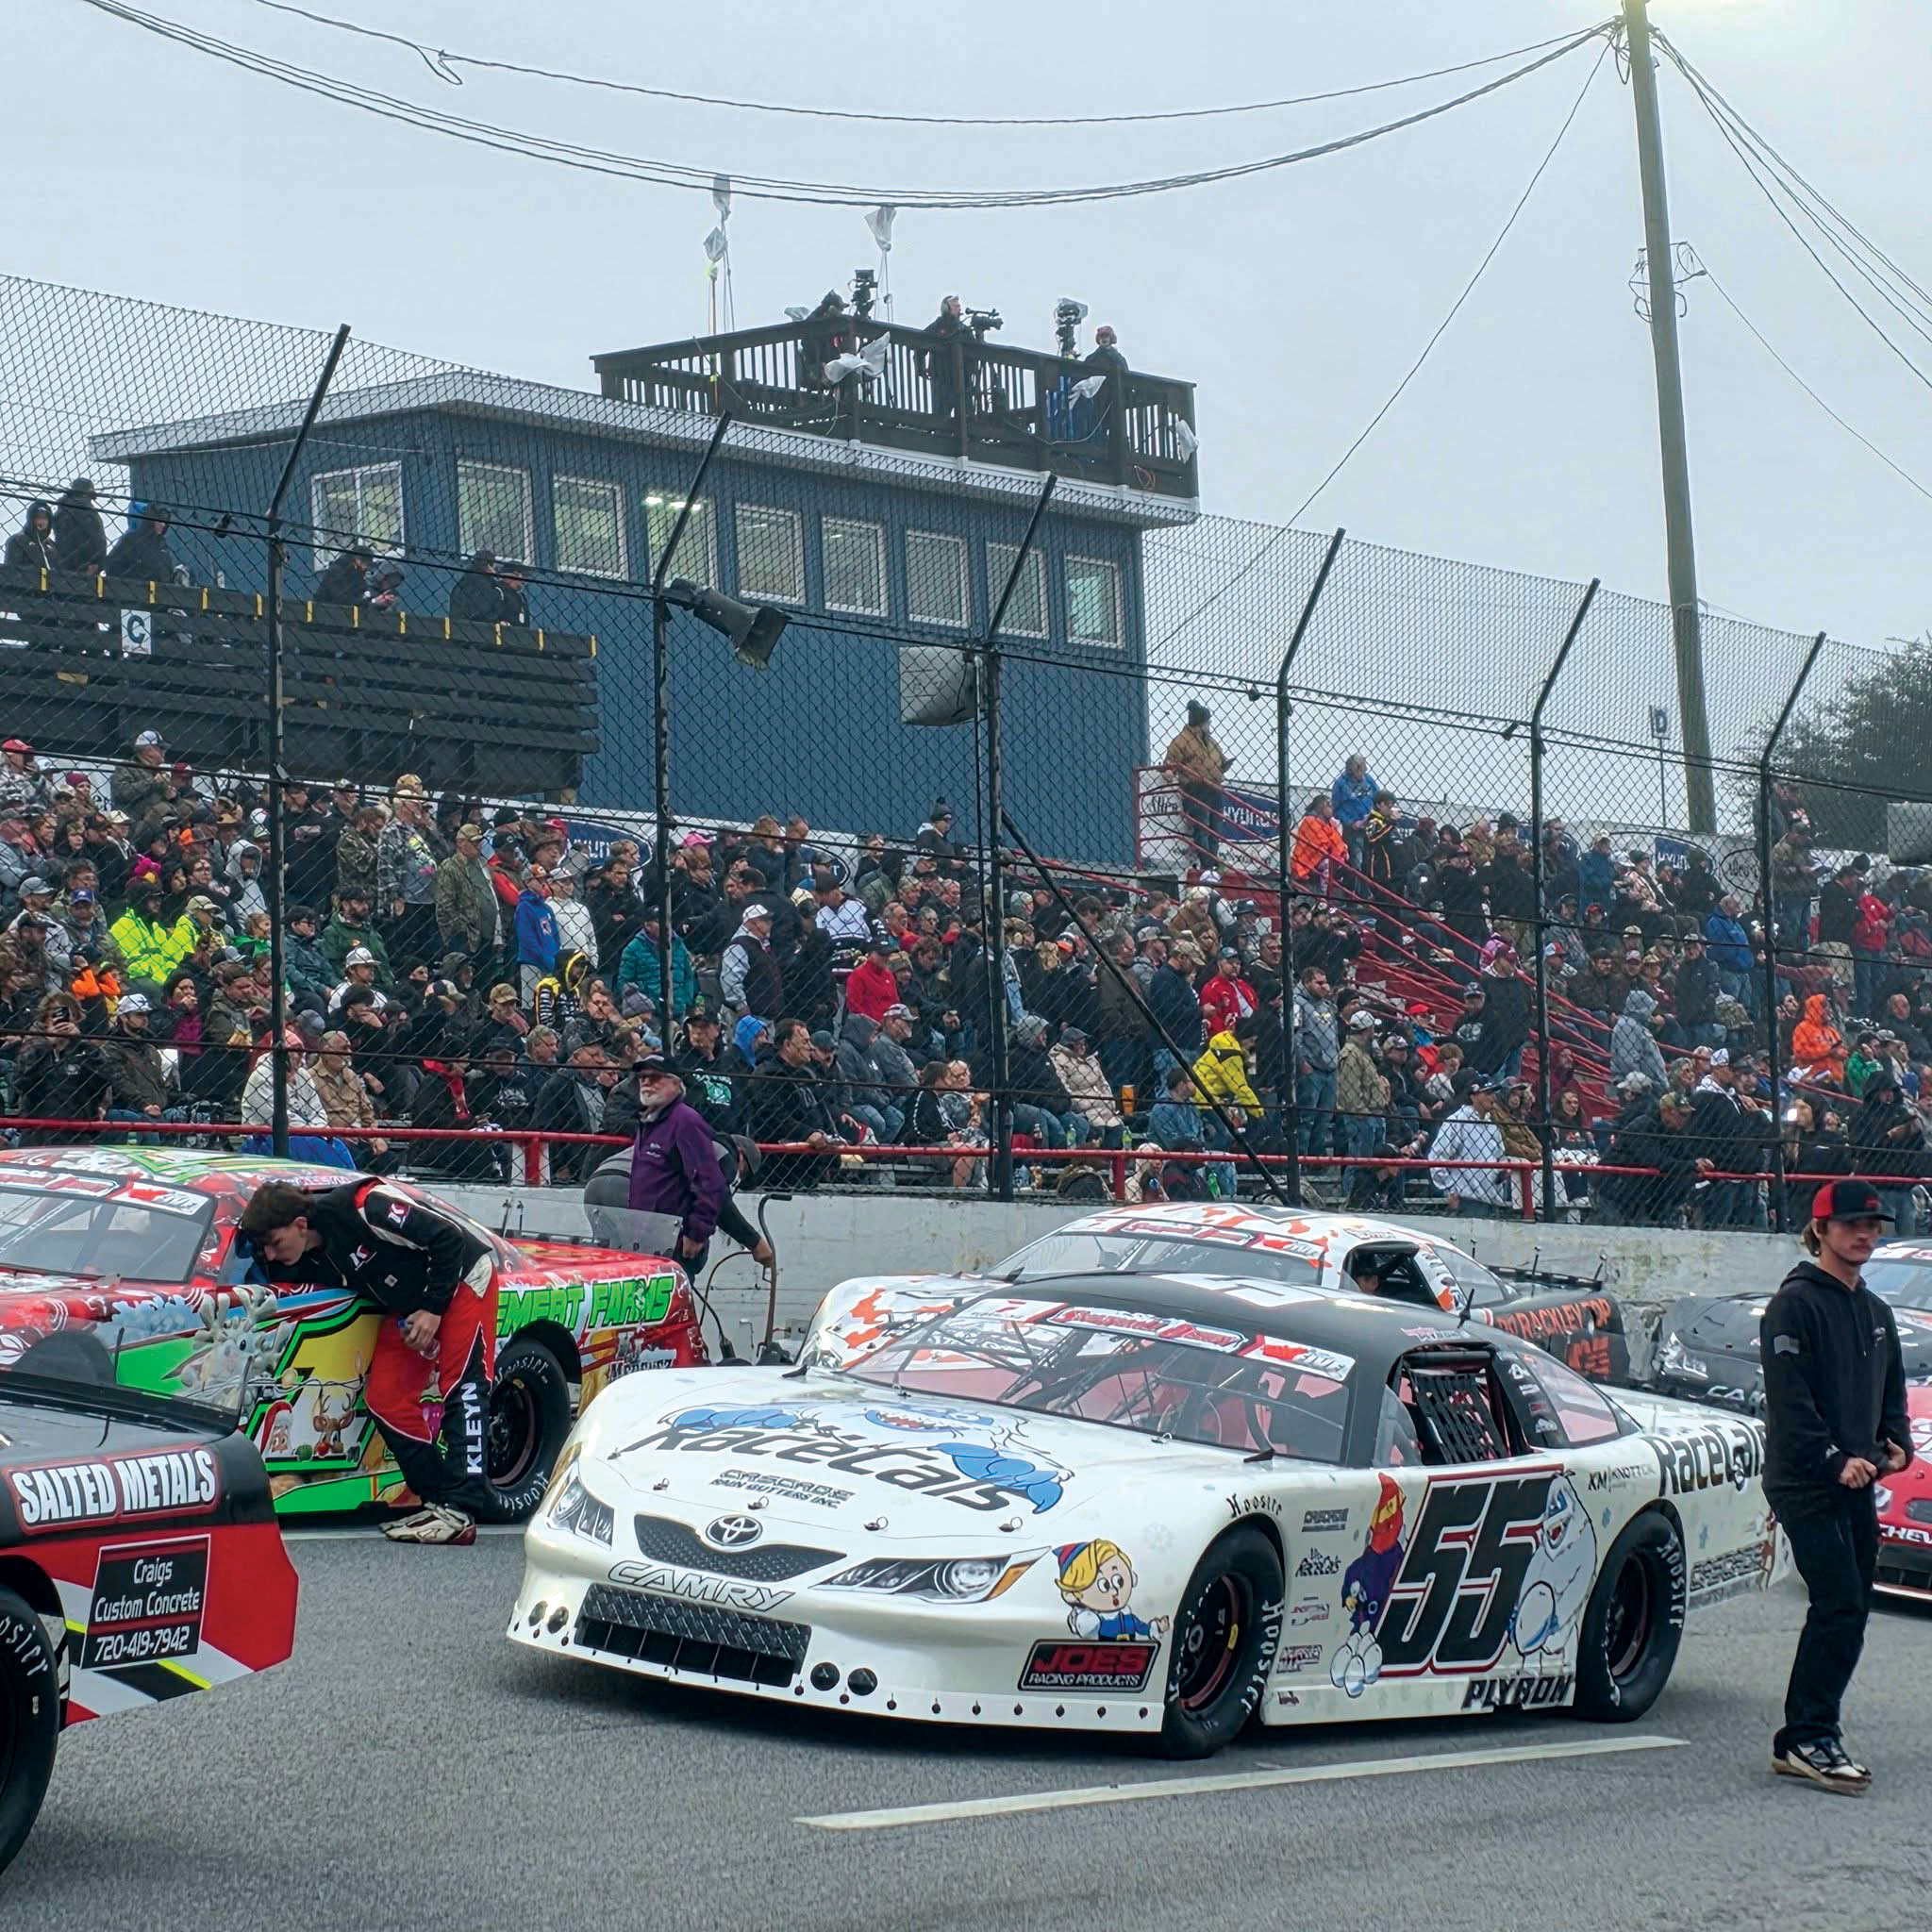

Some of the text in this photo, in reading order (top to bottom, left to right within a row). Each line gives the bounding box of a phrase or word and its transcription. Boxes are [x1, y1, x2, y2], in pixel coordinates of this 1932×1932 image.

[127, 615, 145, 643] C
[1655, 709, 1667, 733] D
[460, 1382, 483, 1474] KLEYN
[11, 1450, 216, 1524] SALTED METALS
[745, 1485, 812, 1501] GUTTERS
[133, 1557, 174, 1588] Craigs
[608, 1559, 797, 1612] CAMRY
[1378, 1474, 1558, 1672] 55
[94, 1587, 201, 1623] Custom Concrete
[94, 1625, 191, 1662] 720-419-7942
[1029, 1644, 1150, 1674] JOES
[1028, 1673, 1141, 1687] RACING PRODUCTS
